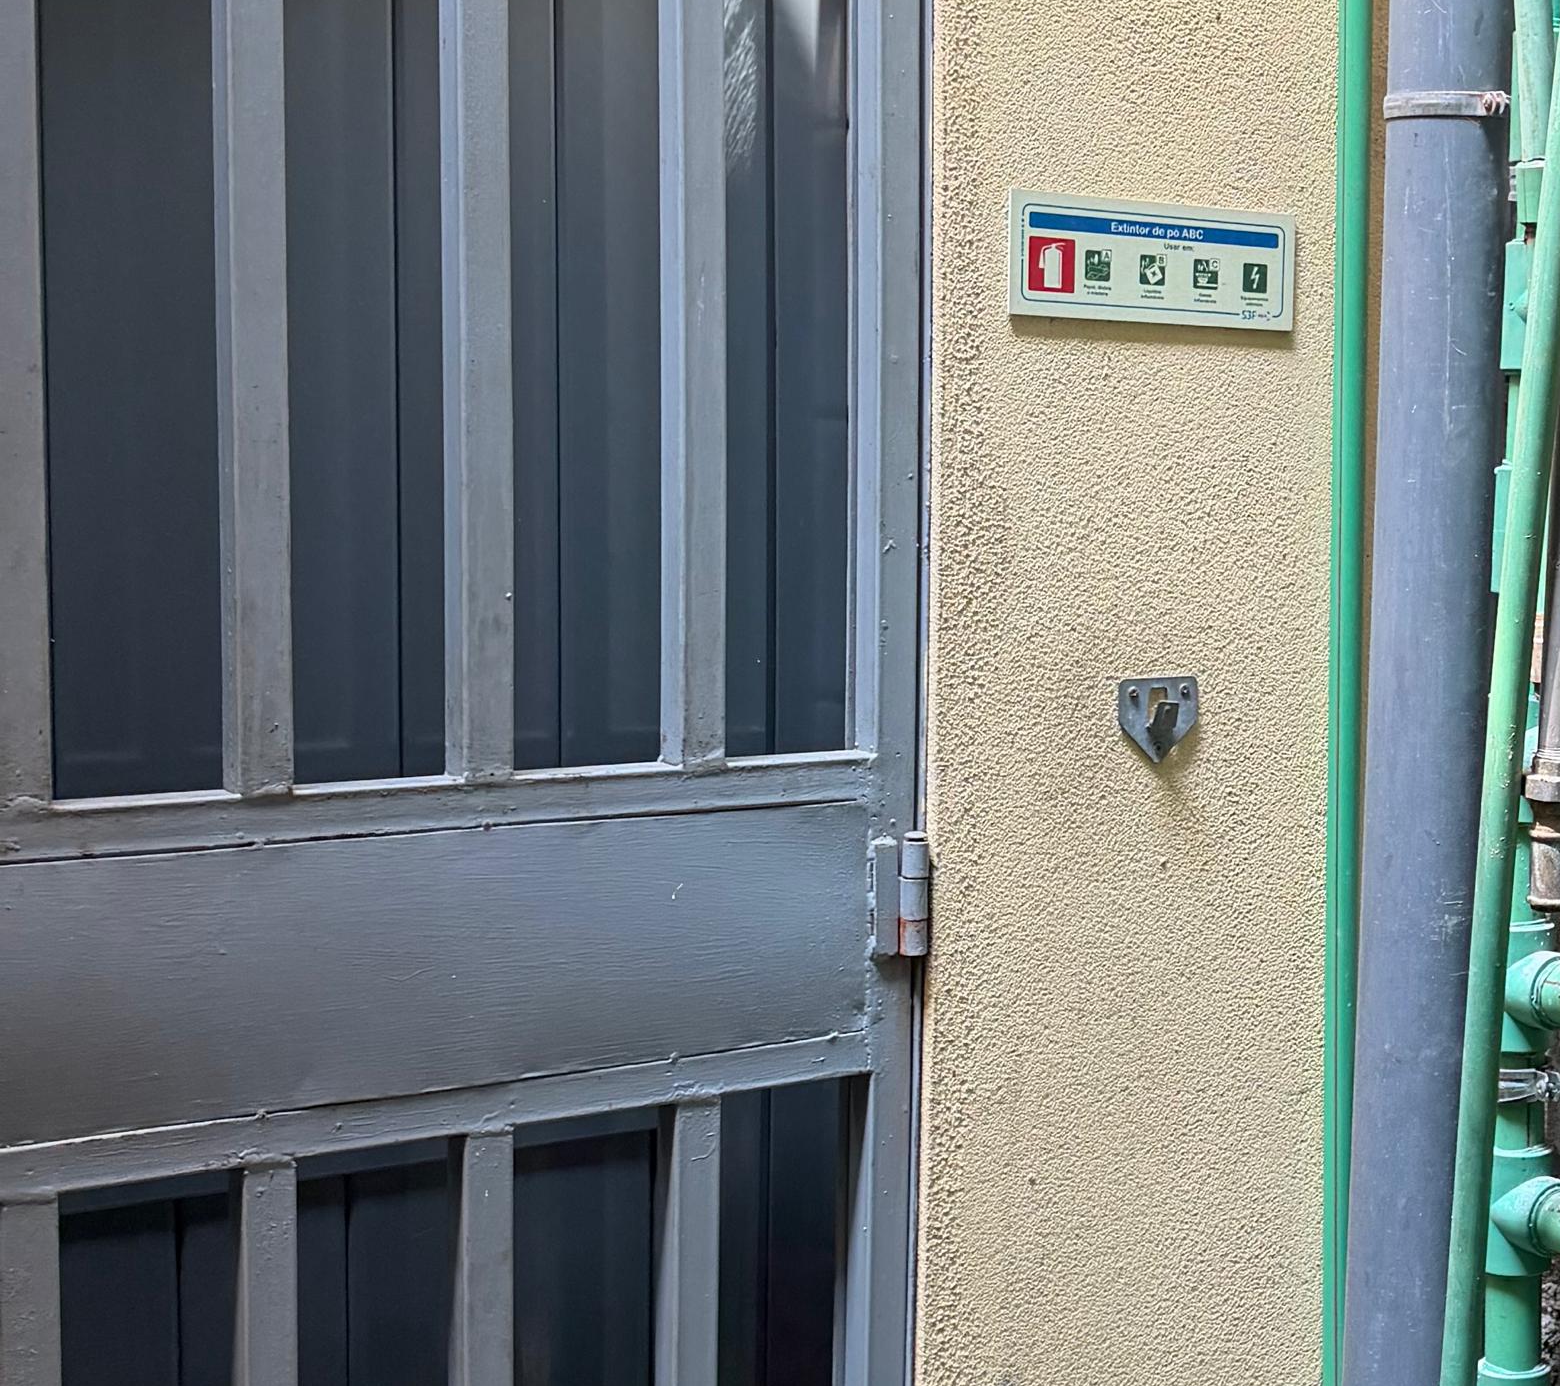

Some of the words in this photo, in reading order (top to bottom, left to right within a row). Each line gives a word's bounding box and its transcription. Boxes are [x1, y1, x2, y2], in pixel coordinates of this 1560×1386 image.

[1110, 221, 1150, 235] Extintor
[1152, 226, 1165, 237] de
[1181, 229, 1204, 240] ABC
[1163, 243, 1180, 251] Usar
